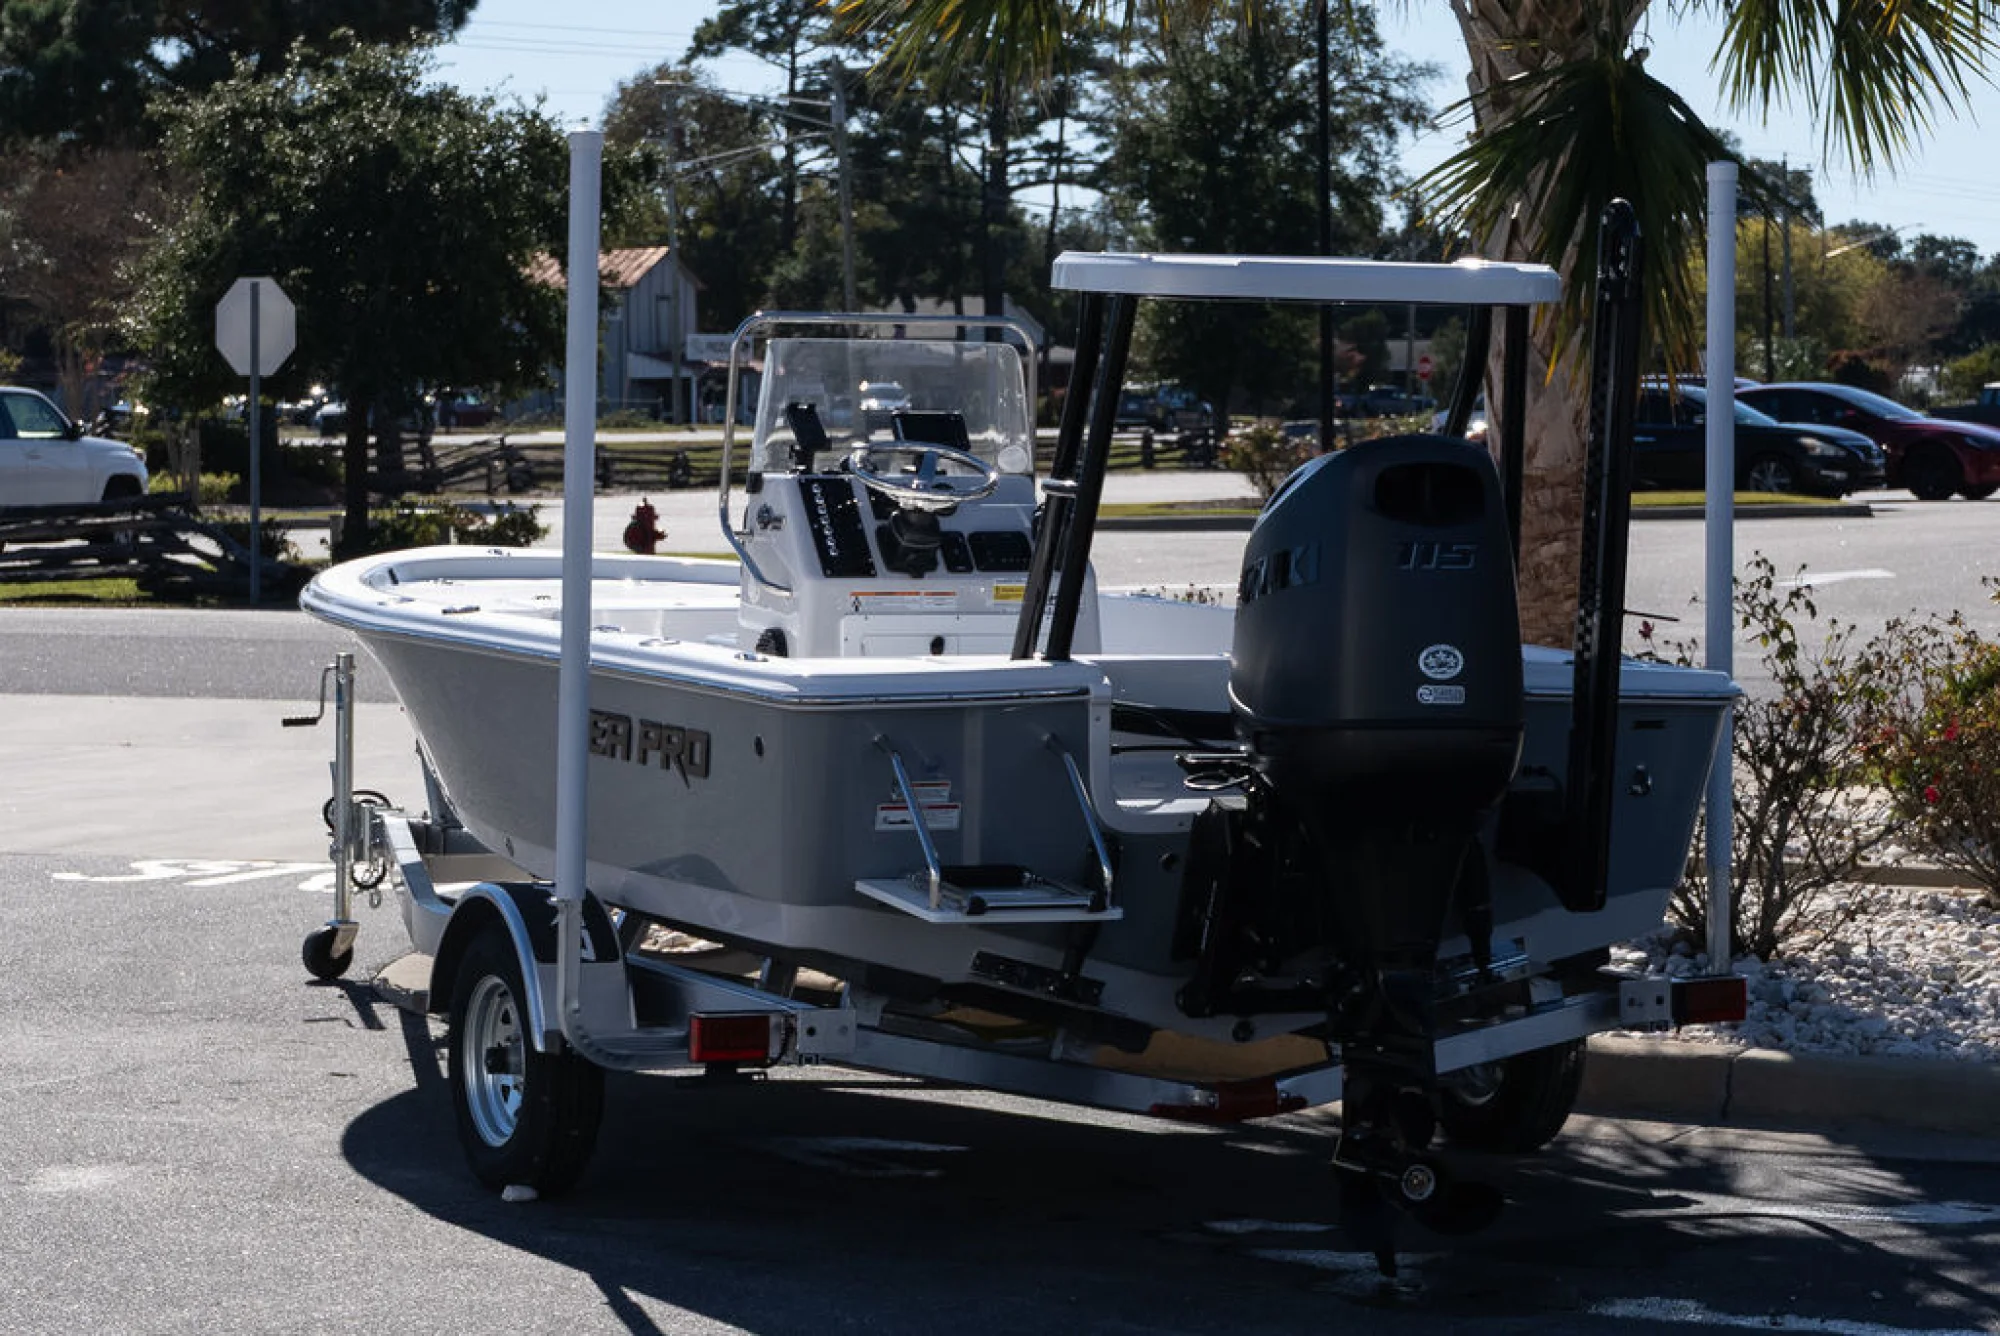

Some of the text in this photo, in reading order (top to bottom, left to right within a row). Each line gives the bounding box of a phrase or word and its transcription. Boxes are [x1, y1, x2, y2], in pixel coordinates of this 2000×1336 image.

[1396, 541, 1479, 573] 115
[589, 708, 711, 789] EA PRO
